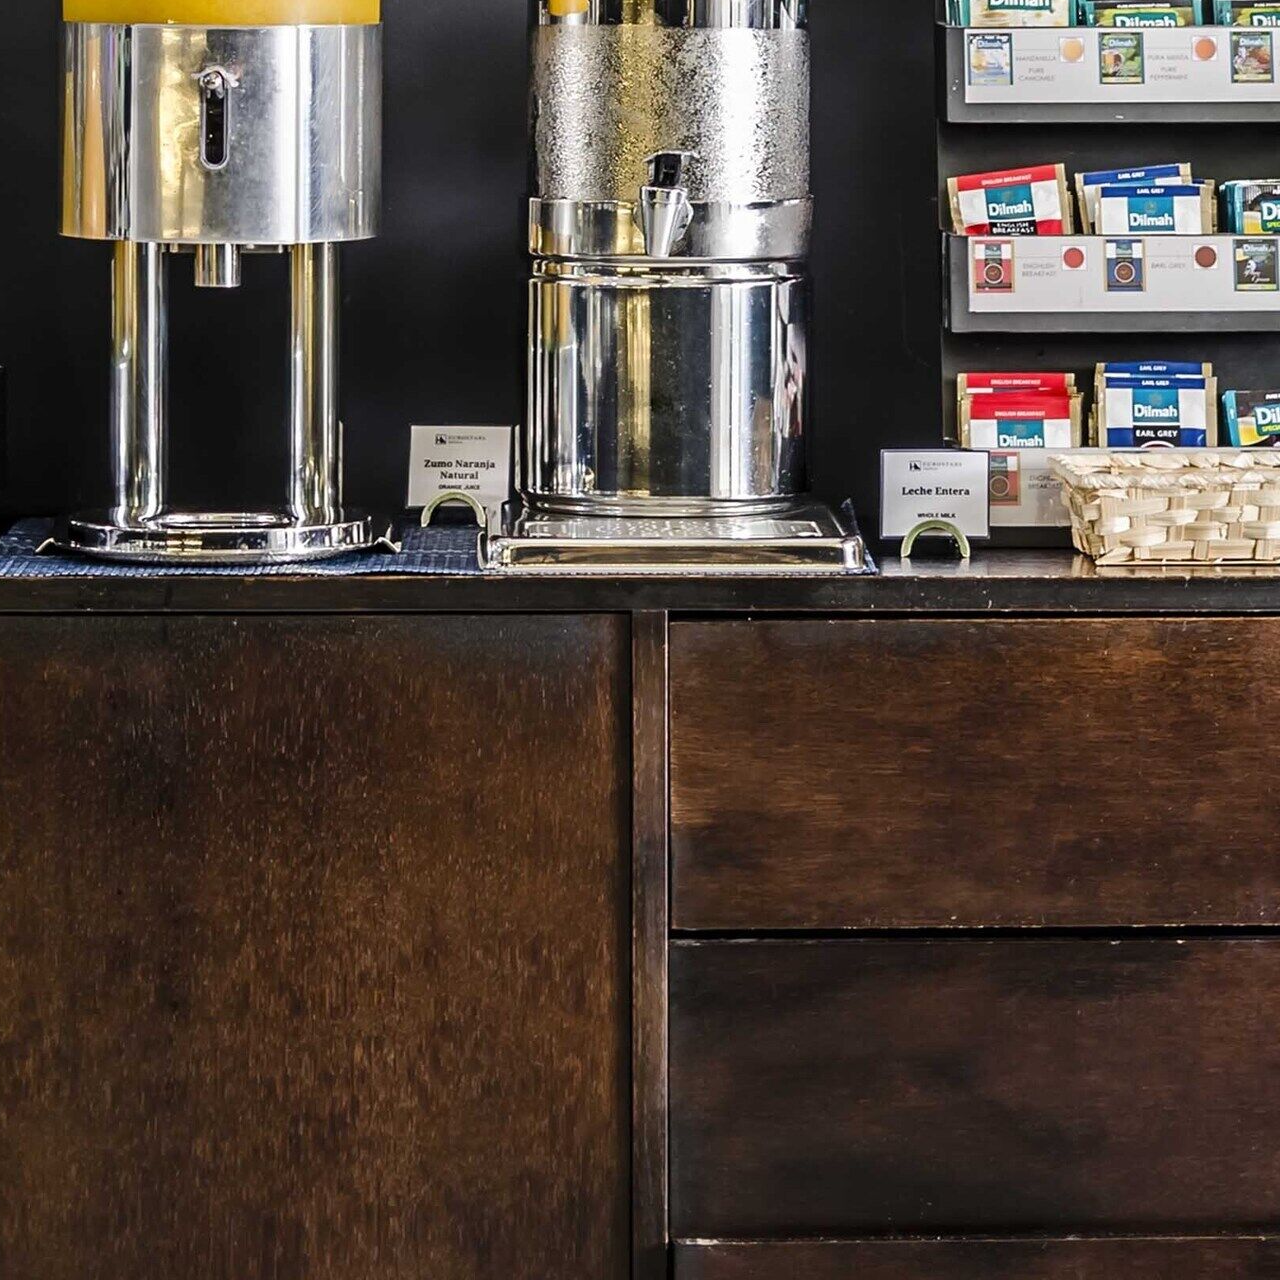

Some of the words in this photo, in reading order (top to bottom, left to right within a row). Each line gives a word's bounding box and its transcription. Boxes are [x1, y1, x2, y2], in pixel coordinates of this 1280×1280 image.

[1115, 16, 1176, 27] Dilmah
[988, 200, 1032, 216] Dilmah
[1129, 213, 1173, 226] Dilmah
[1134, 404, 1178, 417] Dilmah
[1135, 429, 1154, 437] EARL
[1157, 429, 1178, 437] GREY
[999, 434, 1043, 447] Dilmah
[424, 459, 453, 468] Zumo
[455, 459, 495, 470] Naranja
[440, 471, 479, 480] Natural
[902, 486, 933, 496] Leche
[935, 487, 970, 496] Entera
